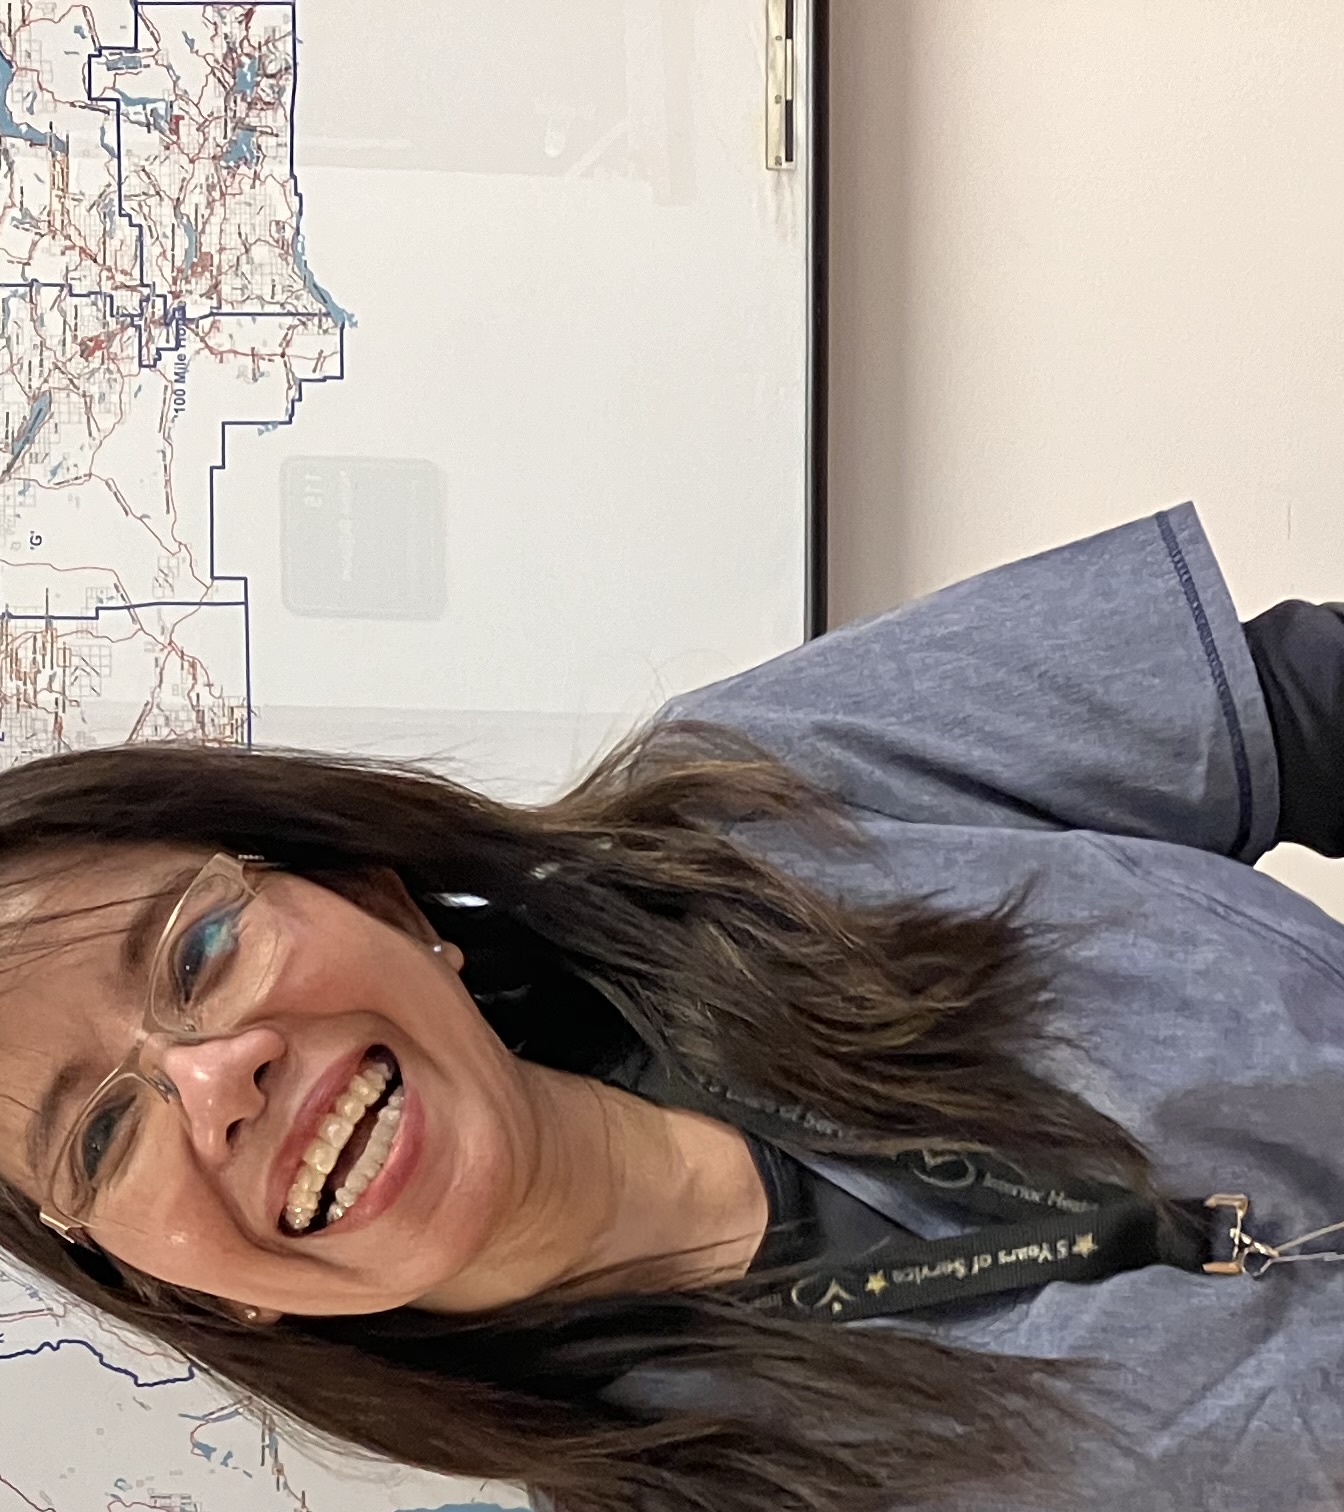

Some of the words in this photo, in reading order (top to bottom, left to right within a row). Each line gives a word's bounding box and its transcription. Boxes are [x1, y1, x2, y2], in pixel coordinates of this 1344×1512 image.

[173, 353, 186, 384] Mile
[30, 530, 42, 550] 'G'
[997, 1242, 1054, 1264] Years
[1056, 1238, 1070, 1260] 5
[891, 1256, 966, 1286] Service
[970, 1253, 993, 1275] of
